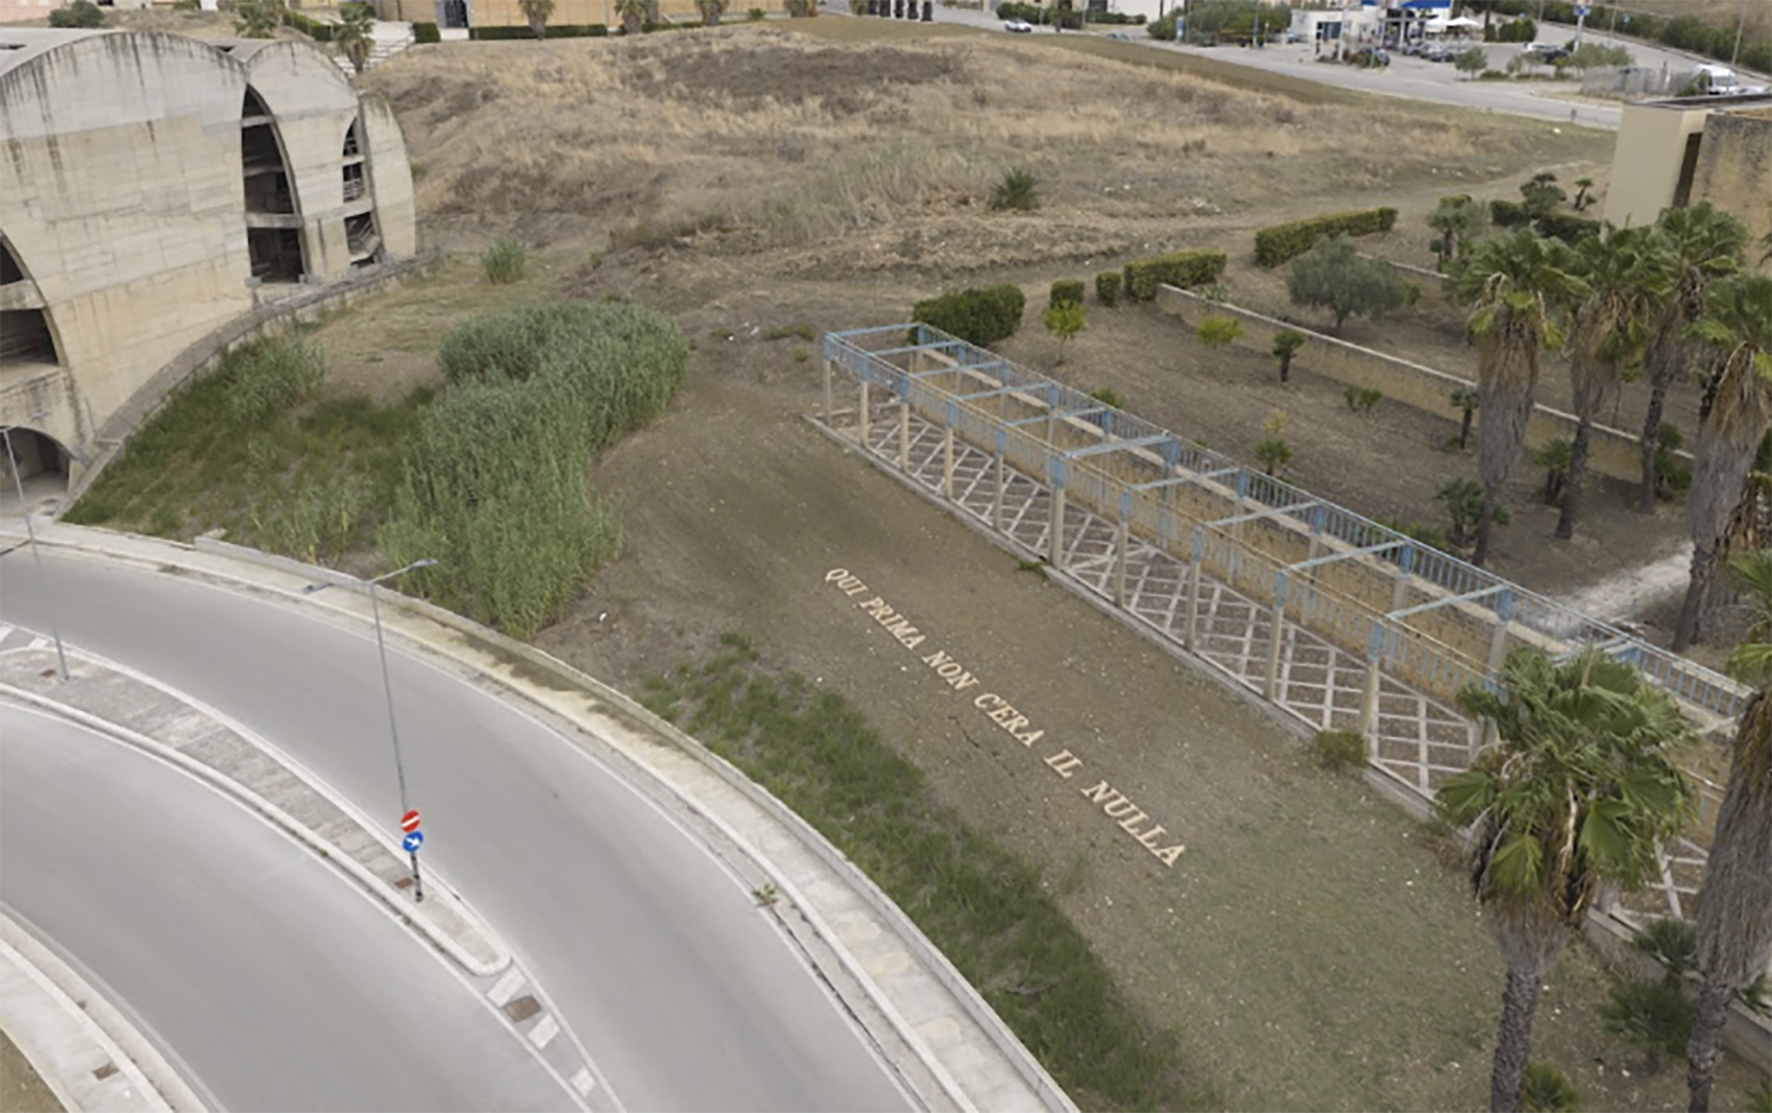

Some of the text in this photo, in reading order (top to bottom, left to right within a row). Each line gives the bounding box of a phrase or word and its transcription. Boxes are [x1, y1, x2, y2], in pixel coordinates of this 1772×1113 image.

[825, 568, 868, 597] QUI
[860, 597, 926, 650] PRIMA
[922, 650, 980, 690] NON
[1043, 749, 1083, 778] IL
[1081, 780, 1185, 868] NULLA
